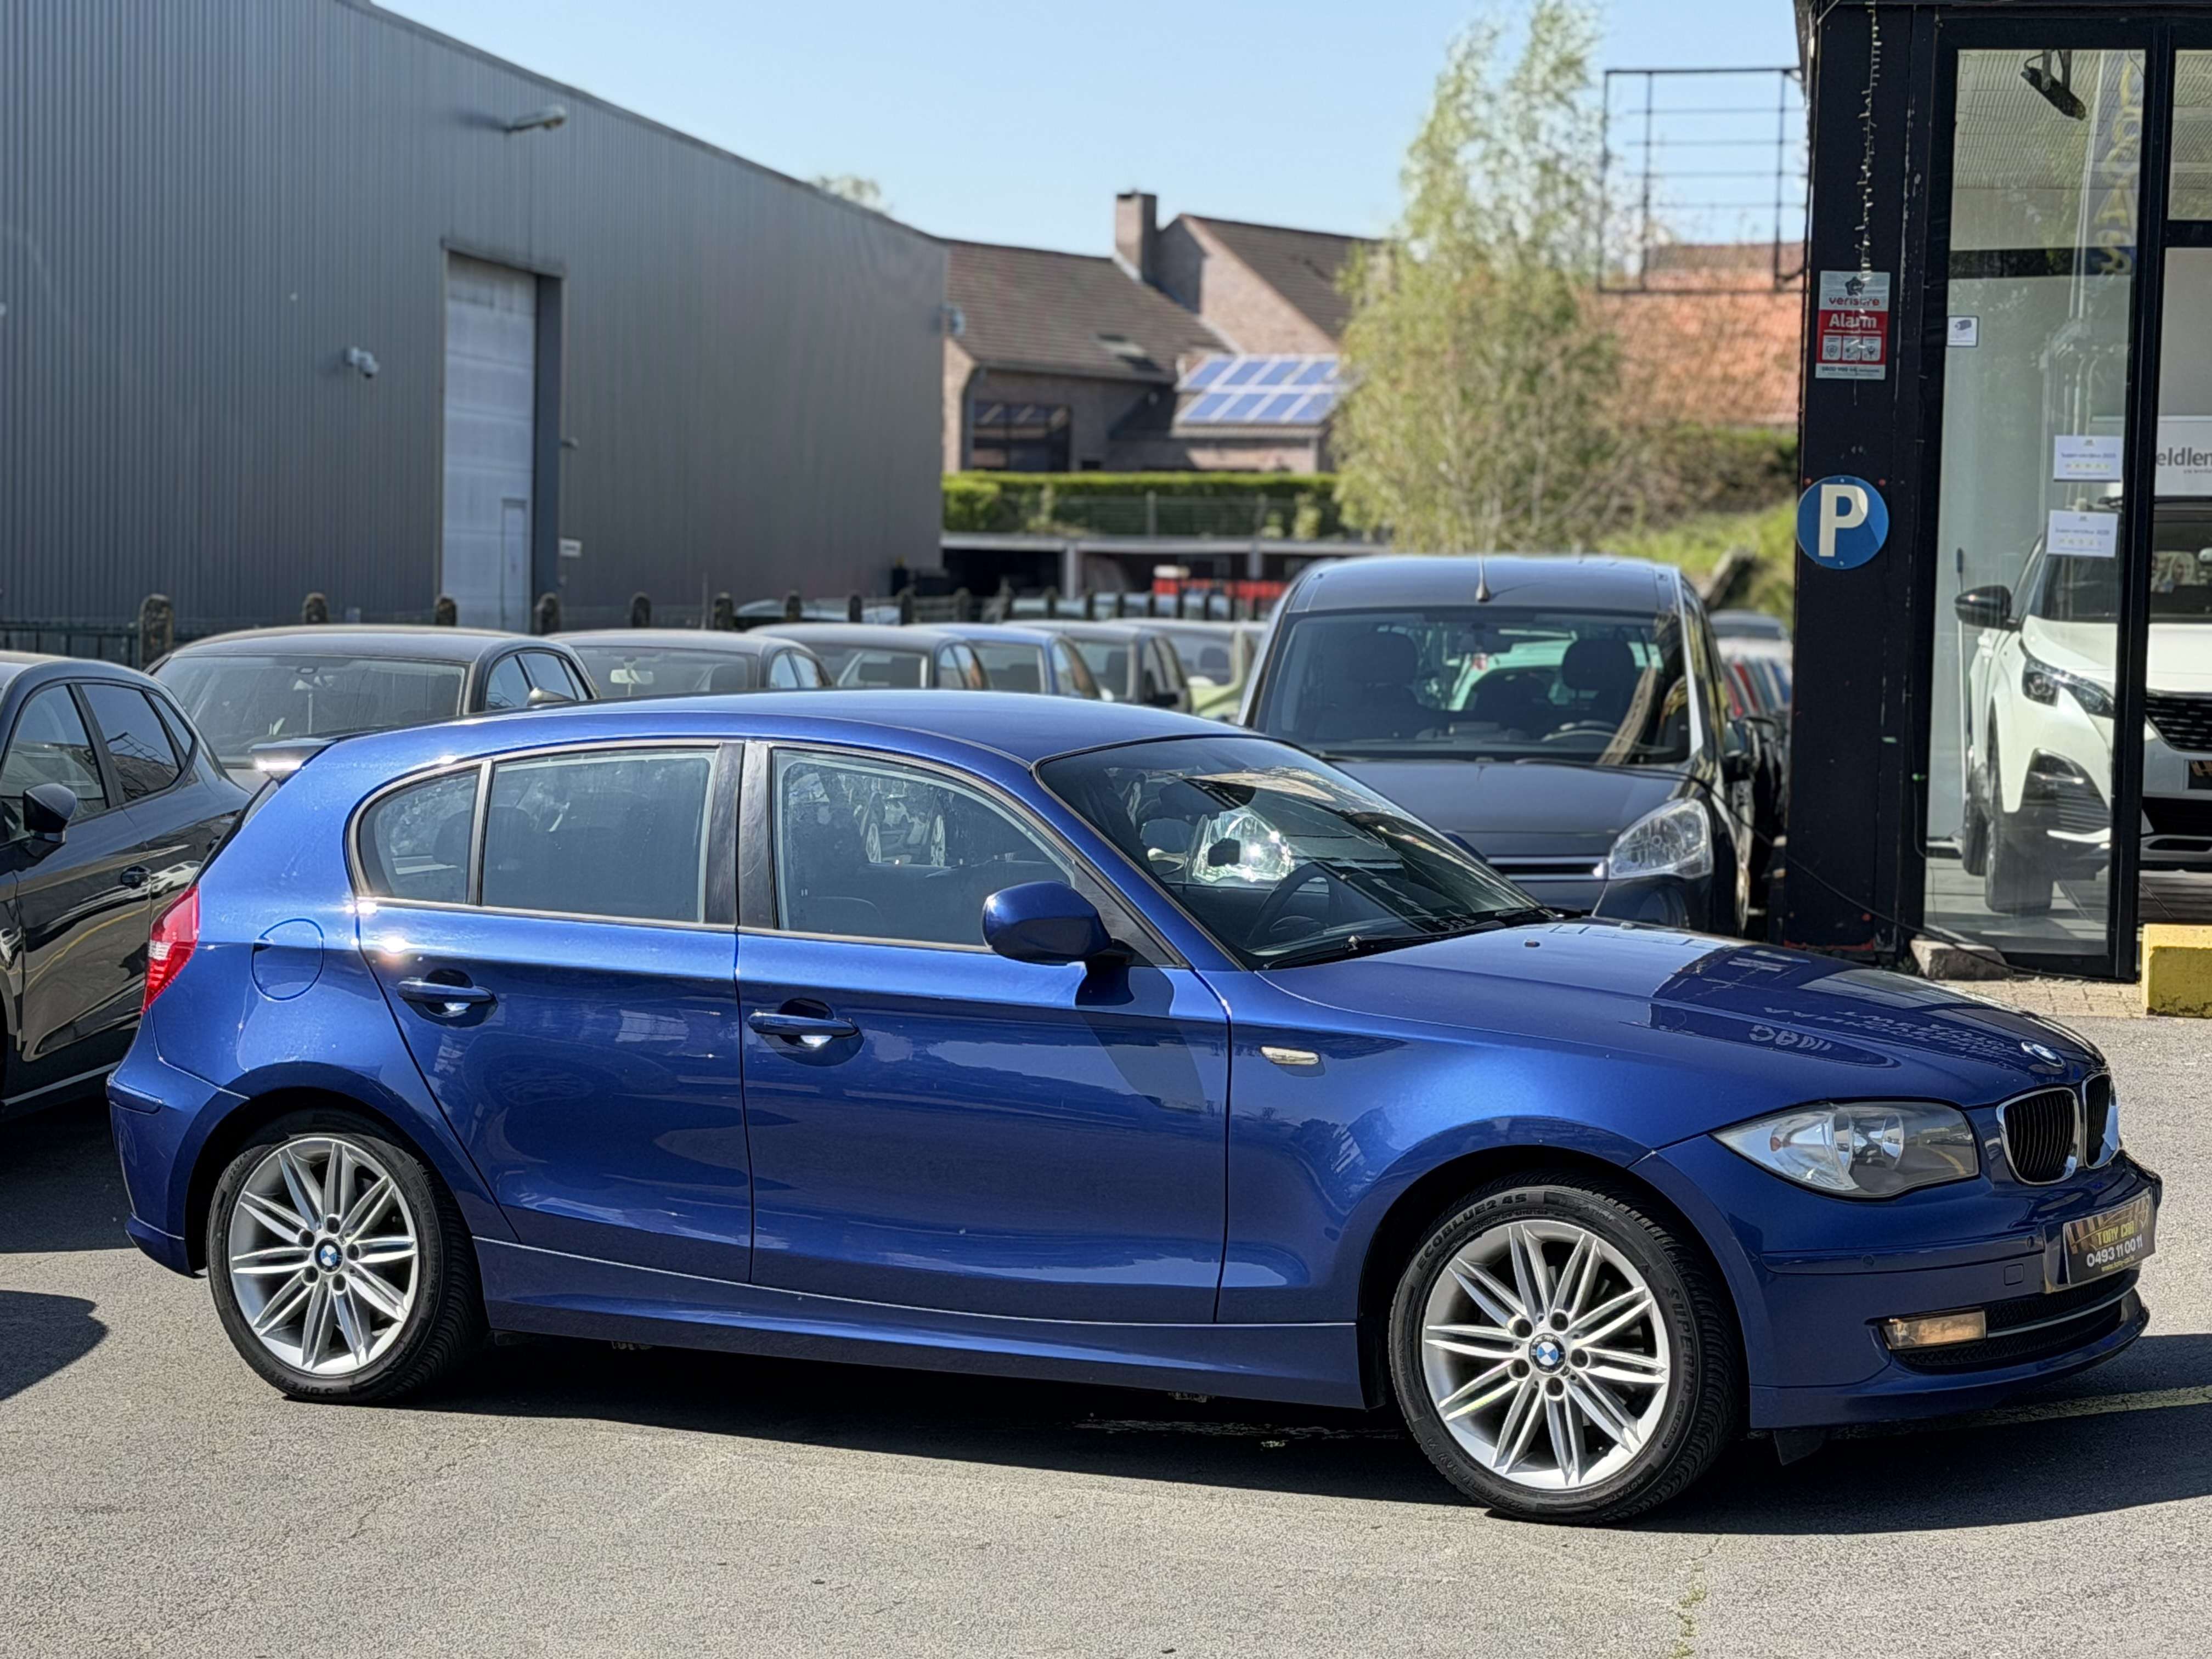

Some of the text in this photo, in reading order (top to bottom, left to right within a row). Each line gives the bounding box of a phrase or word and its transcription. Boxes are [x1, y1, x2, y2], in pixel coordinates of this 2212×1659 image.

[1829, 313, 1877, 329] Alarm
[1818, 484, 1869, 557] P
[2097, 1226, 2119, 1246] TONY
[2086, 1246, 2115, 1267] 0493
[2116, 1244, 2124, 1257] 11
[2124, 1240, 2136, 1254] 00
[2136, 1233, 2143, 1249] 11
